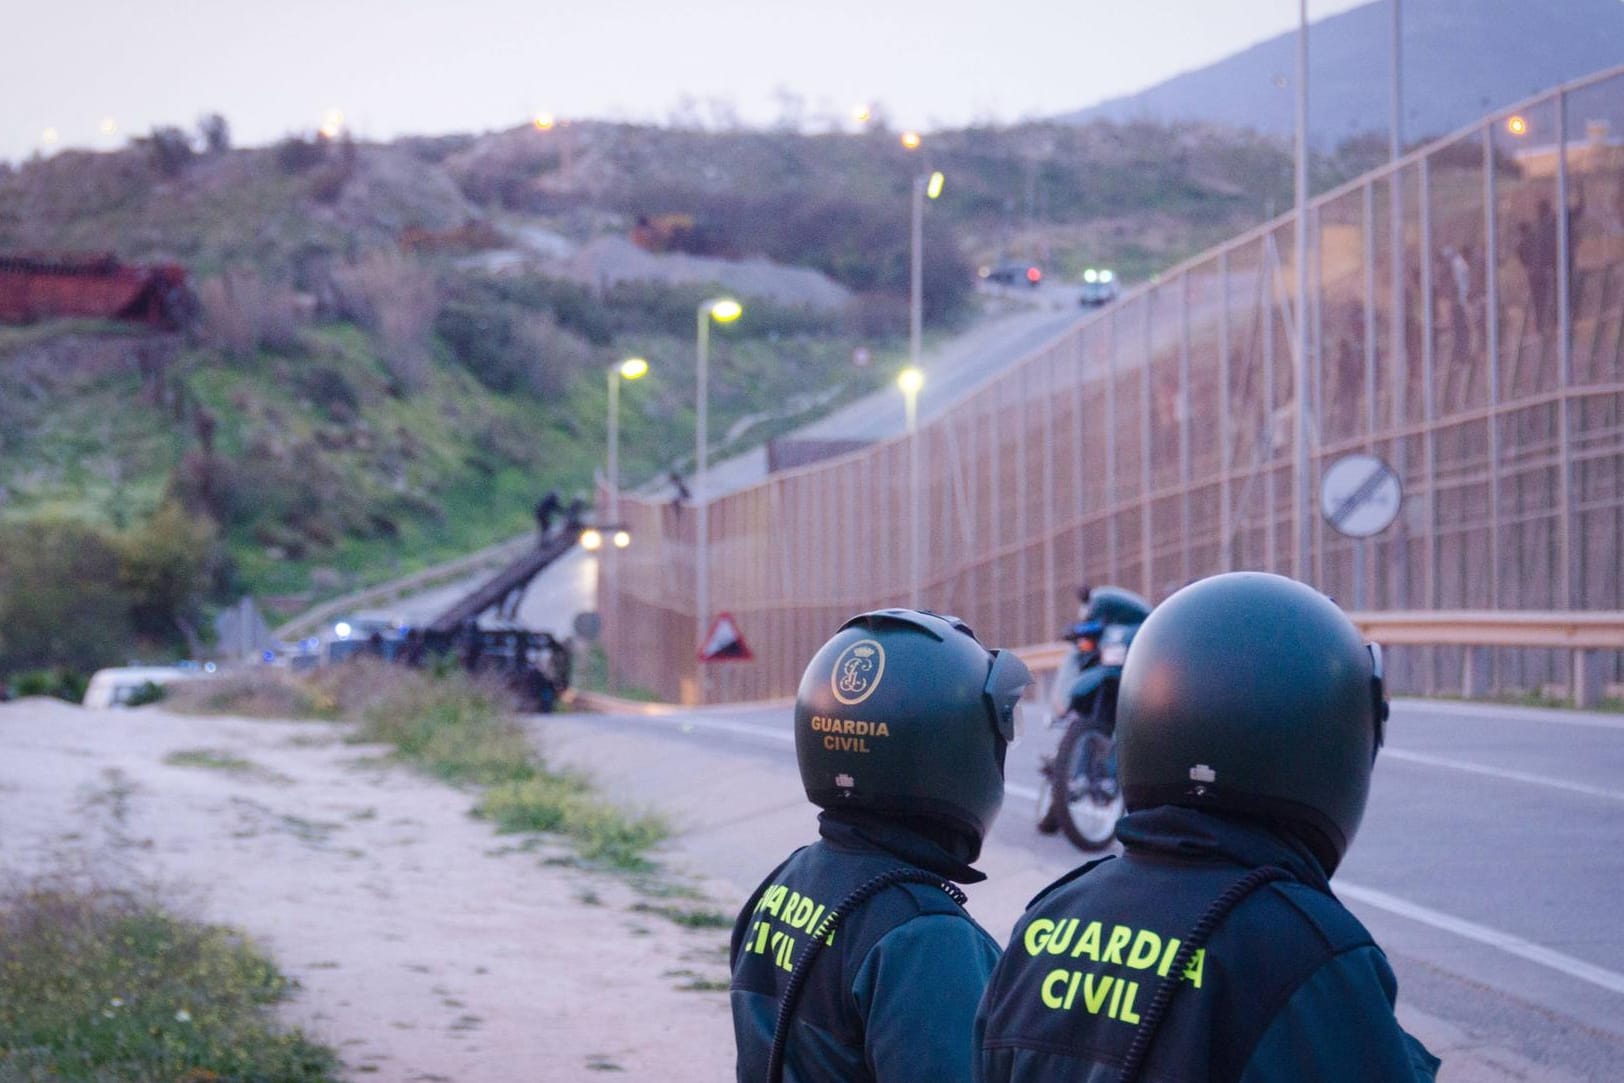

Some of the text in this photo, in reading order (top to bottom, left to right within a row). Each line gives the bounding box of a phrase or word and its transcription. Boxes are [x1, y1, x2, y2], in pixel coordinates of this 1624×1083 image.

[811, 716, 889, 737] GUARDIA
[823, 735, 870, 753] CIVIL
[1041, 969, 1140, 1025] CIVIL
